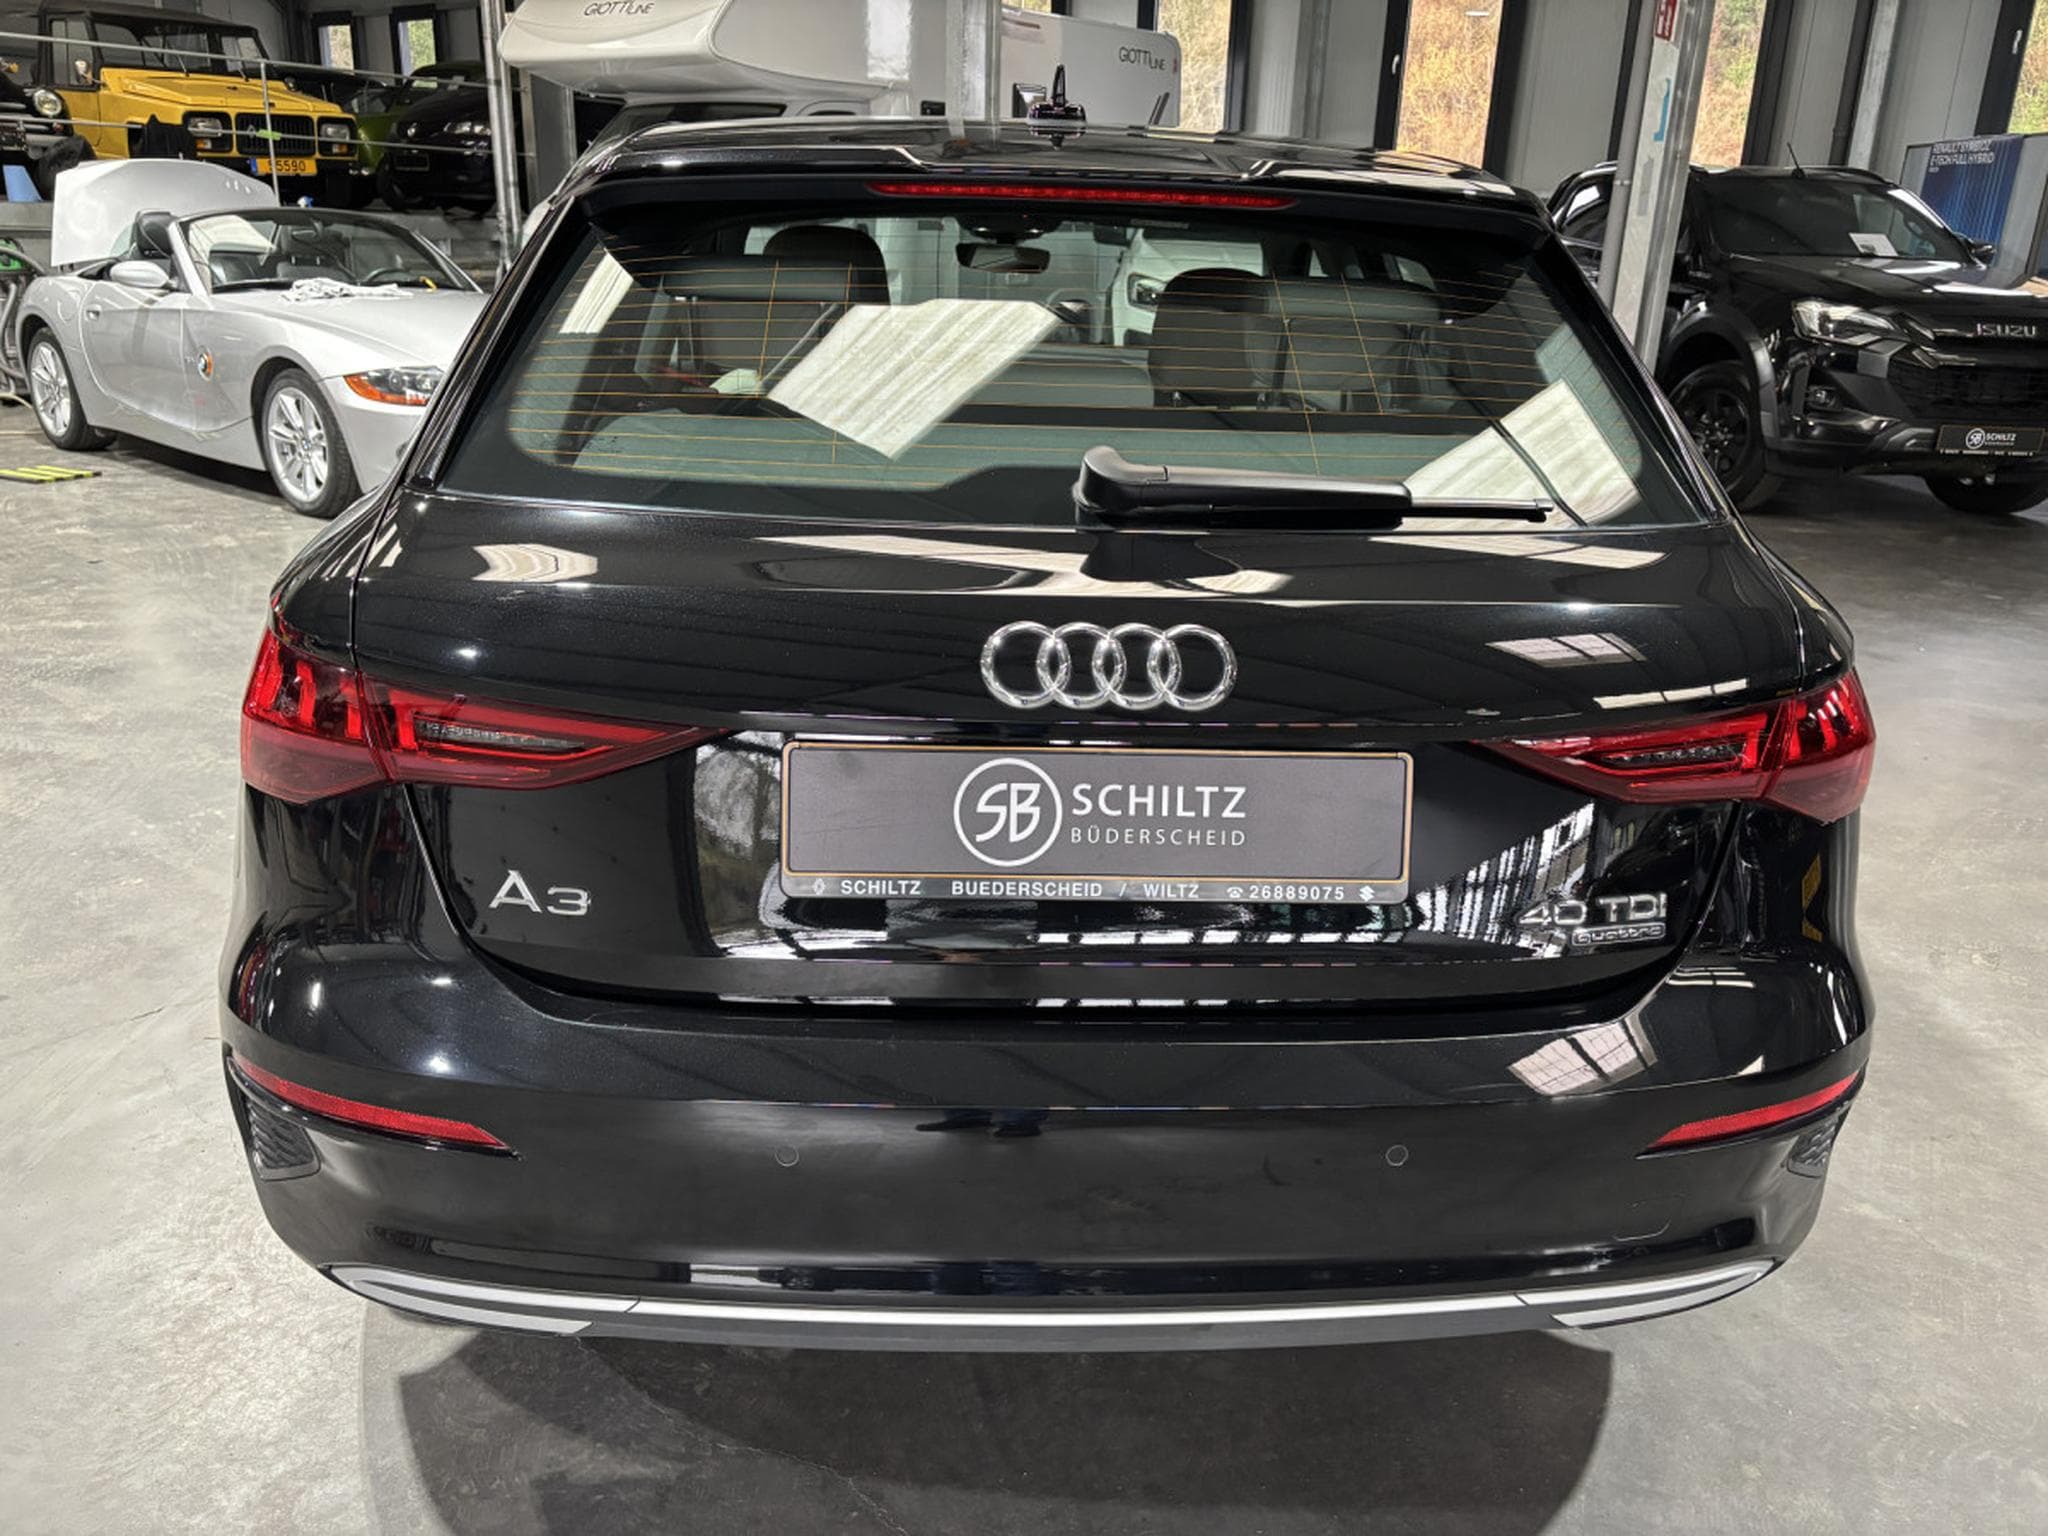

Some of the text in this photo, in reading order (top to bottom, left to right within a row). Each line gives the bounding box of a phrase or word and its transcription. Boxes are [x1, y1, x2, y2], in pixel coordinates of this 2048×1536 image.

[1976, 323, 2036, 338] ISUZU
[1071, 783, 1246, 818] SCHILTZ
[1070, 825, 1246, 846] BÜDERSCHEID
[488, 869, 592, 916] A3
[840, 880, 921, 895] SCHILTZ
[951, 881, 1102, 897] BUEDERSCHEID
[1143, 883, 1200, 898] WILTZ
[1250, 885, 1345, 900] 26889075
[1518, 892, 1668, 926] 40 TDI
[1574, 926, 1663, 943] quattro
